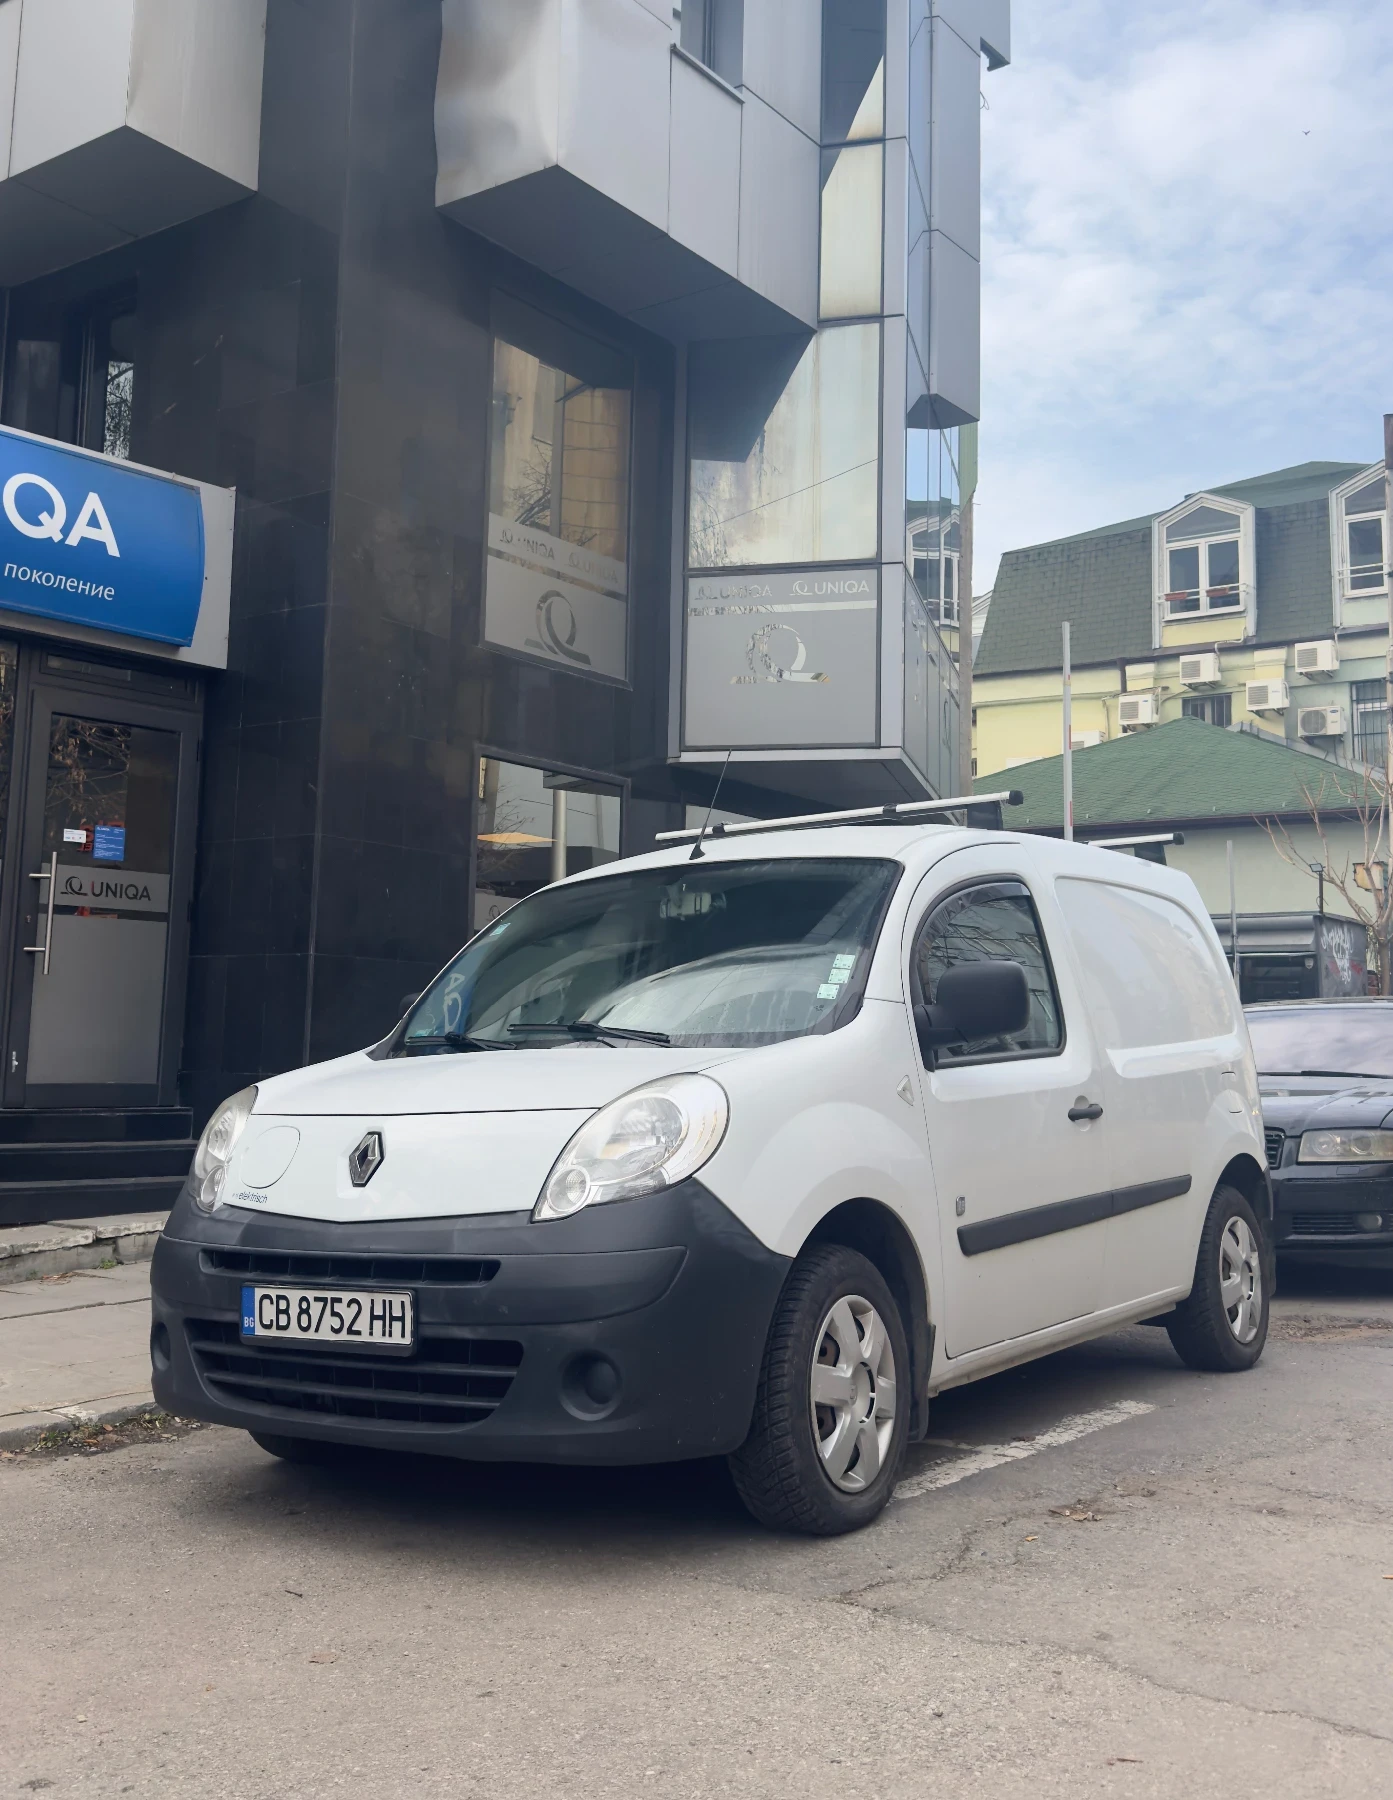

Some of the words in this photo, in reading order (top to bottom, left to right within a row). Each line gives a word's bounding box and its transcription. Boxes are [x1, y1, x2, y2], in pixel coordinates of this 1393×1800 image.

[4, 563, 115, 600] поколение
[814, 580, 870, 596] UNIQA
[91, 881, 151, 901] UNIQA
[244, 1317, 255, 1327] BG
